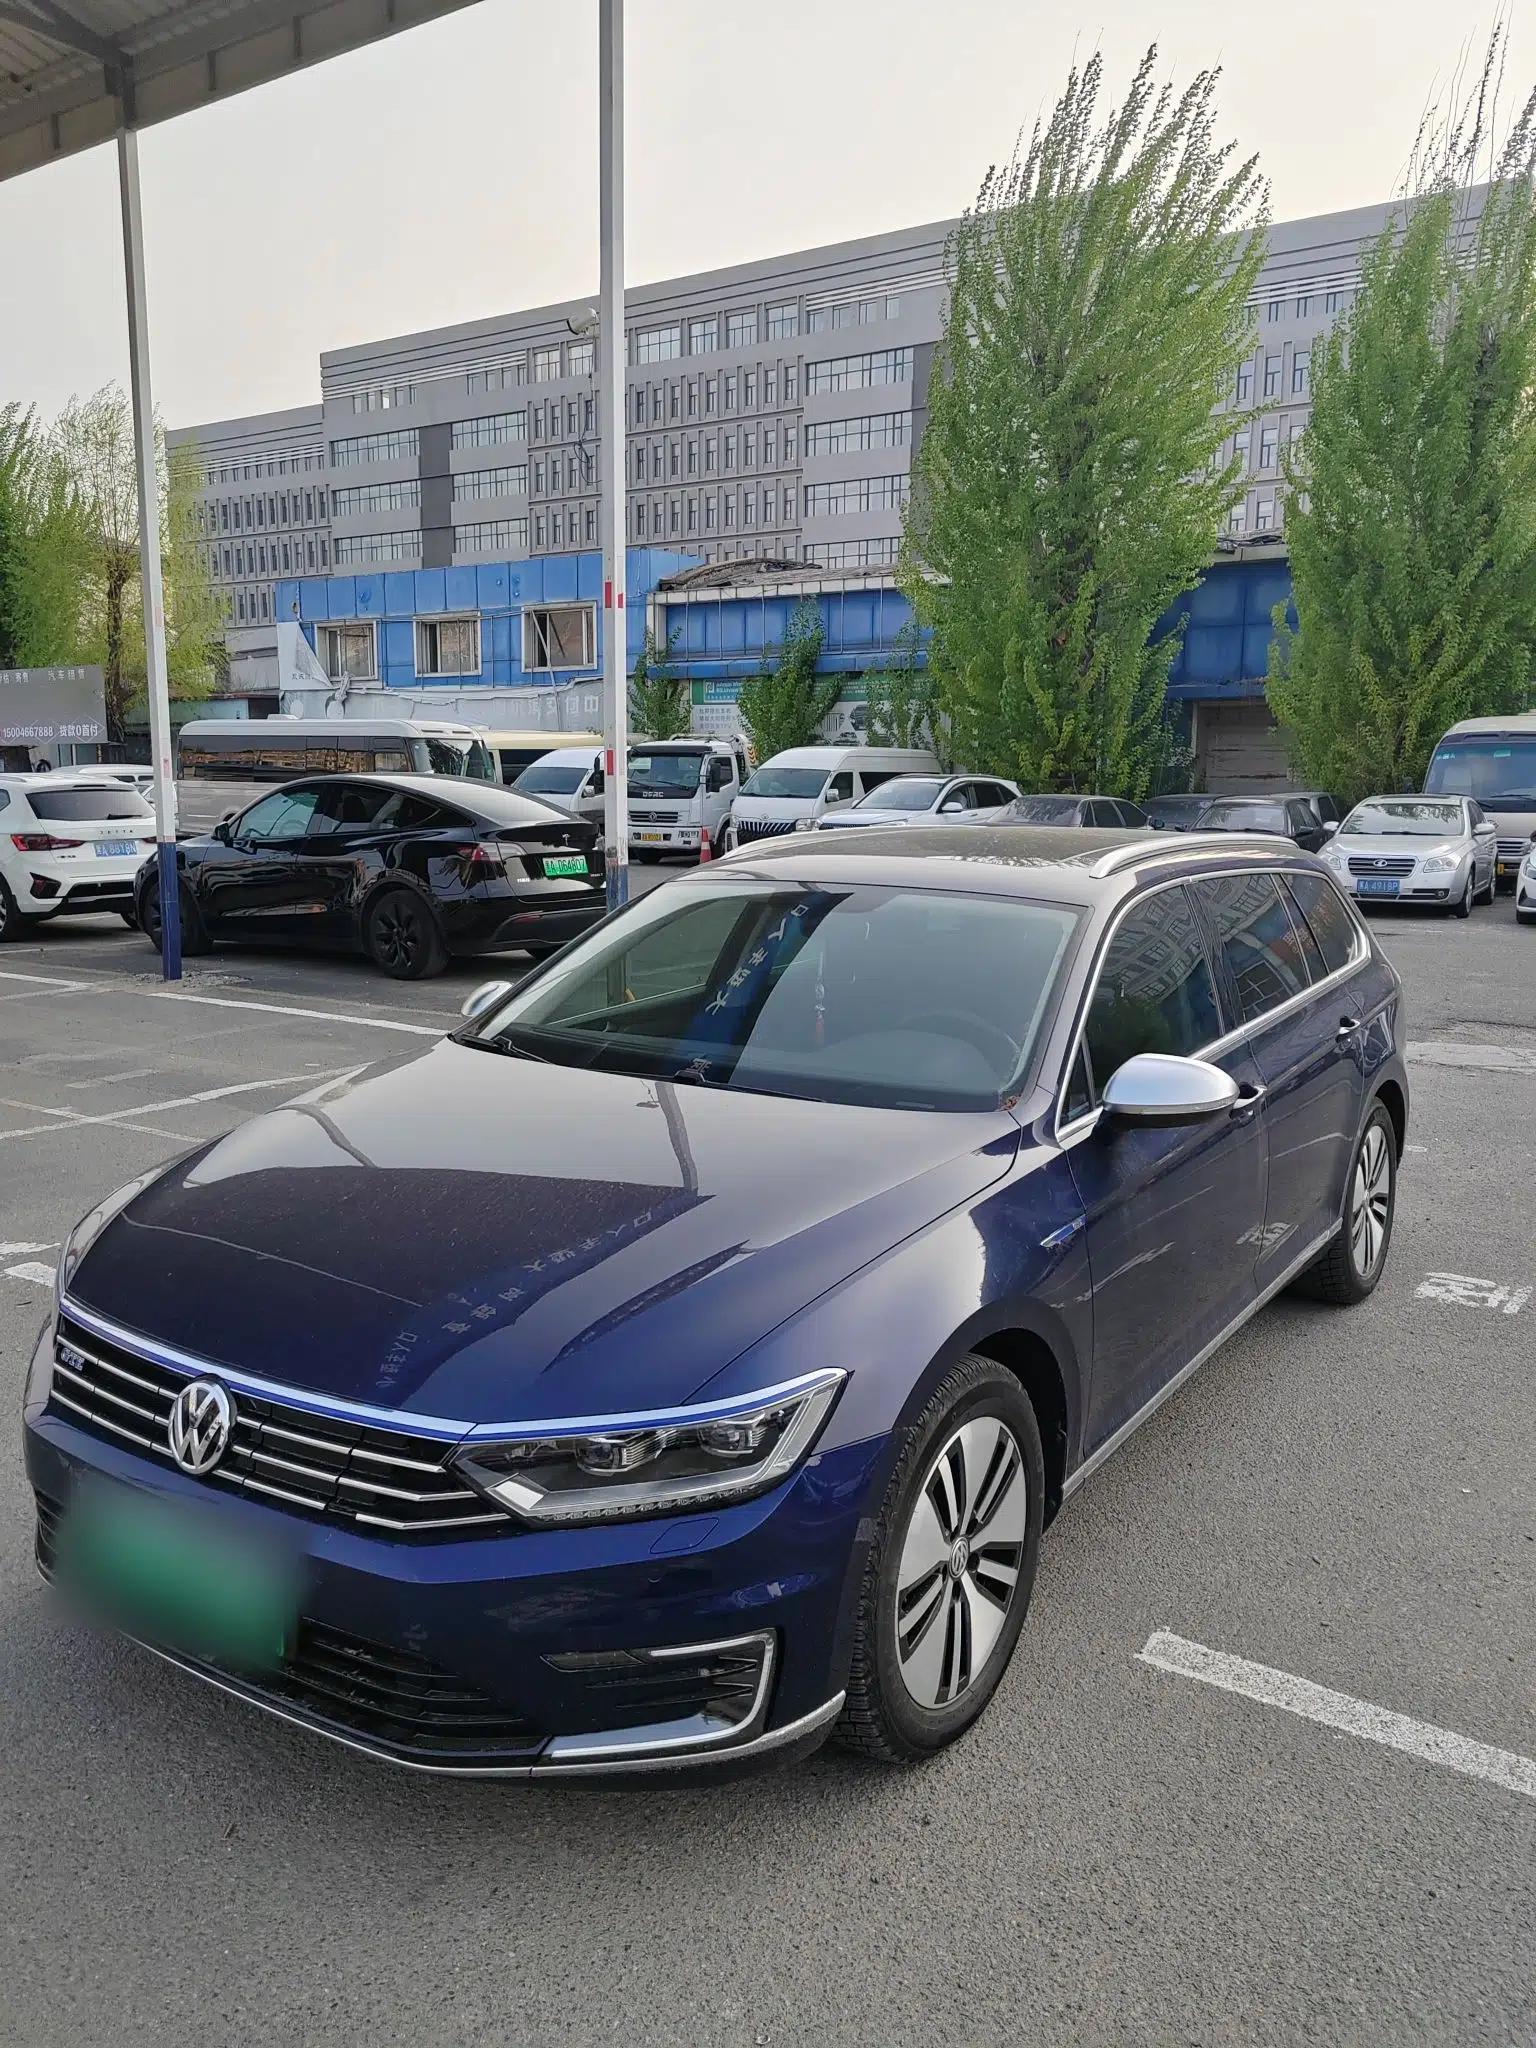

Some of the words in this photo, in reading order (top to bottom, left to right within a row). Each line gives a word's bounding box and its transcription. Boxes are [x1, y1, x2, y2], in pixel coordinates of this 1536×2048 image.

[48, 668, 85, 681] 汽车租赁
[3, 726, 54, 738] 15004667888
[60, 724, 98, 737] 贷款0首付
[60, 1347, 85, 1371] GTE
